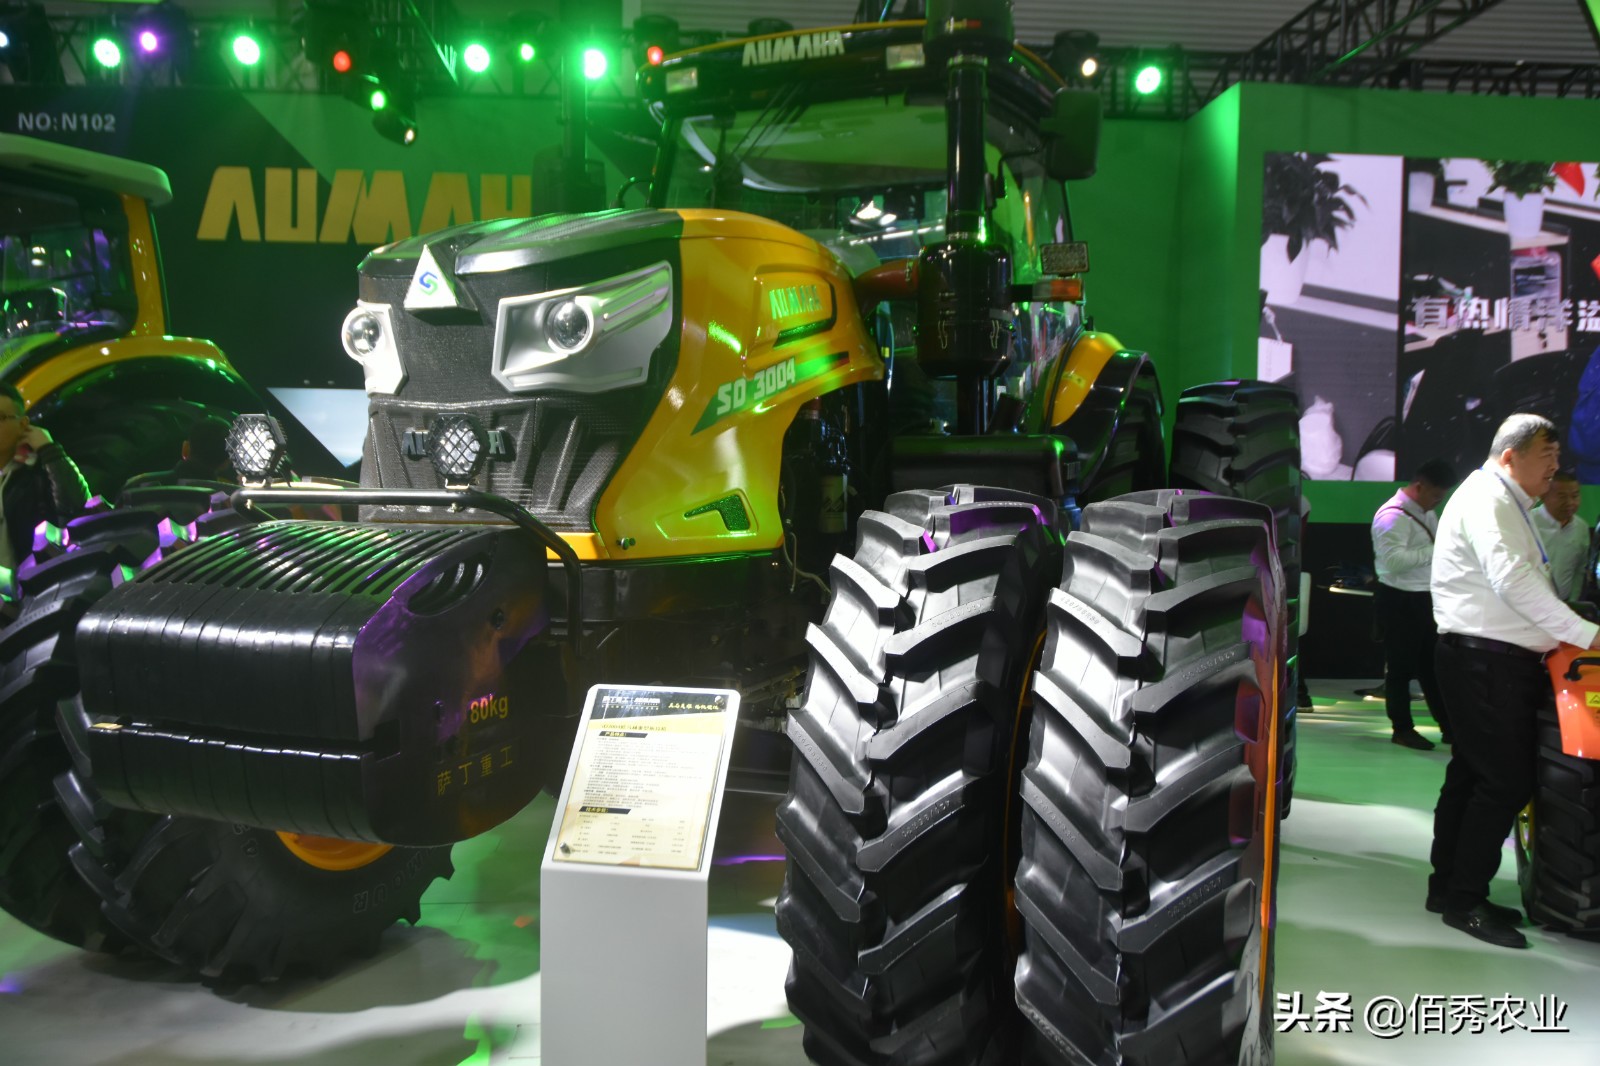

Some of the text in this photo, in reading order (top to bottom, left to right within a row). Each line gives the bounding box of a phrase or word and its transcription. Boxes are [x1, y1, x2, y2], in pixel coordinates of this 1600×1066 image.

[742, 30, 845, 67] AUMAHA
[753, 356, 797, 401] 3004
[470, 695, 509, 724] 80kg
[436, 744, 513, 797] 萨丁重工
